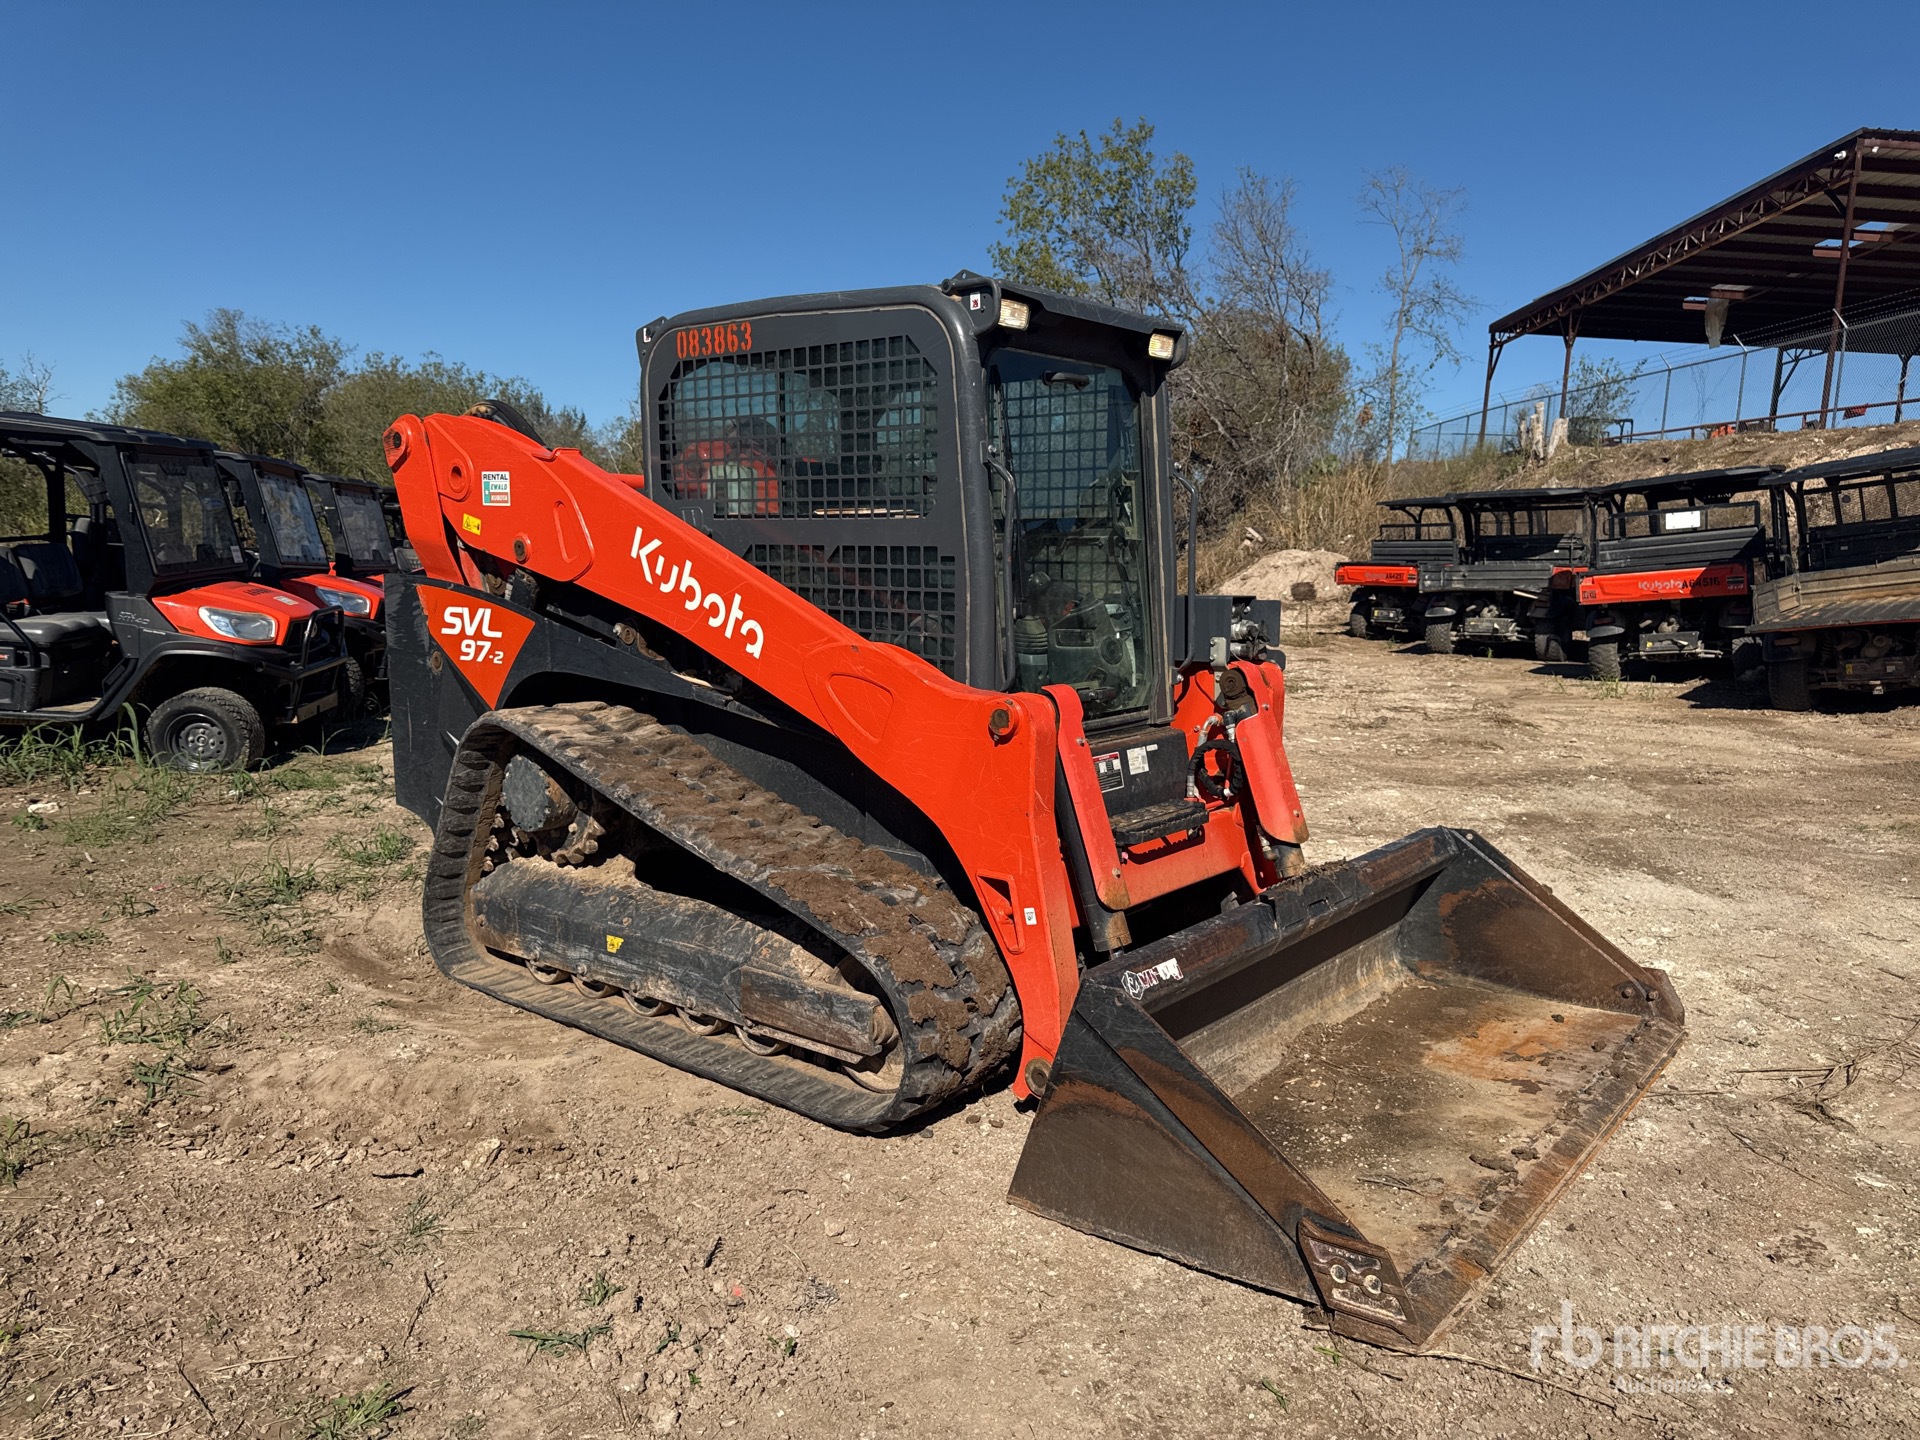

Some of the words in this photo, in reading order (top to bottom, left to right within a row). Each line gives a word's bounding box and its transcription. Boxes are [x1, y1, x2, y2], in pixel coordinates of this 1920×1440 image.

[677, 321, 753, 359] 083863
[630, 525, 765, 660] Kubota
[441, 606, 503, 638] SVL
[460, 638, 504, 665] 97-2
